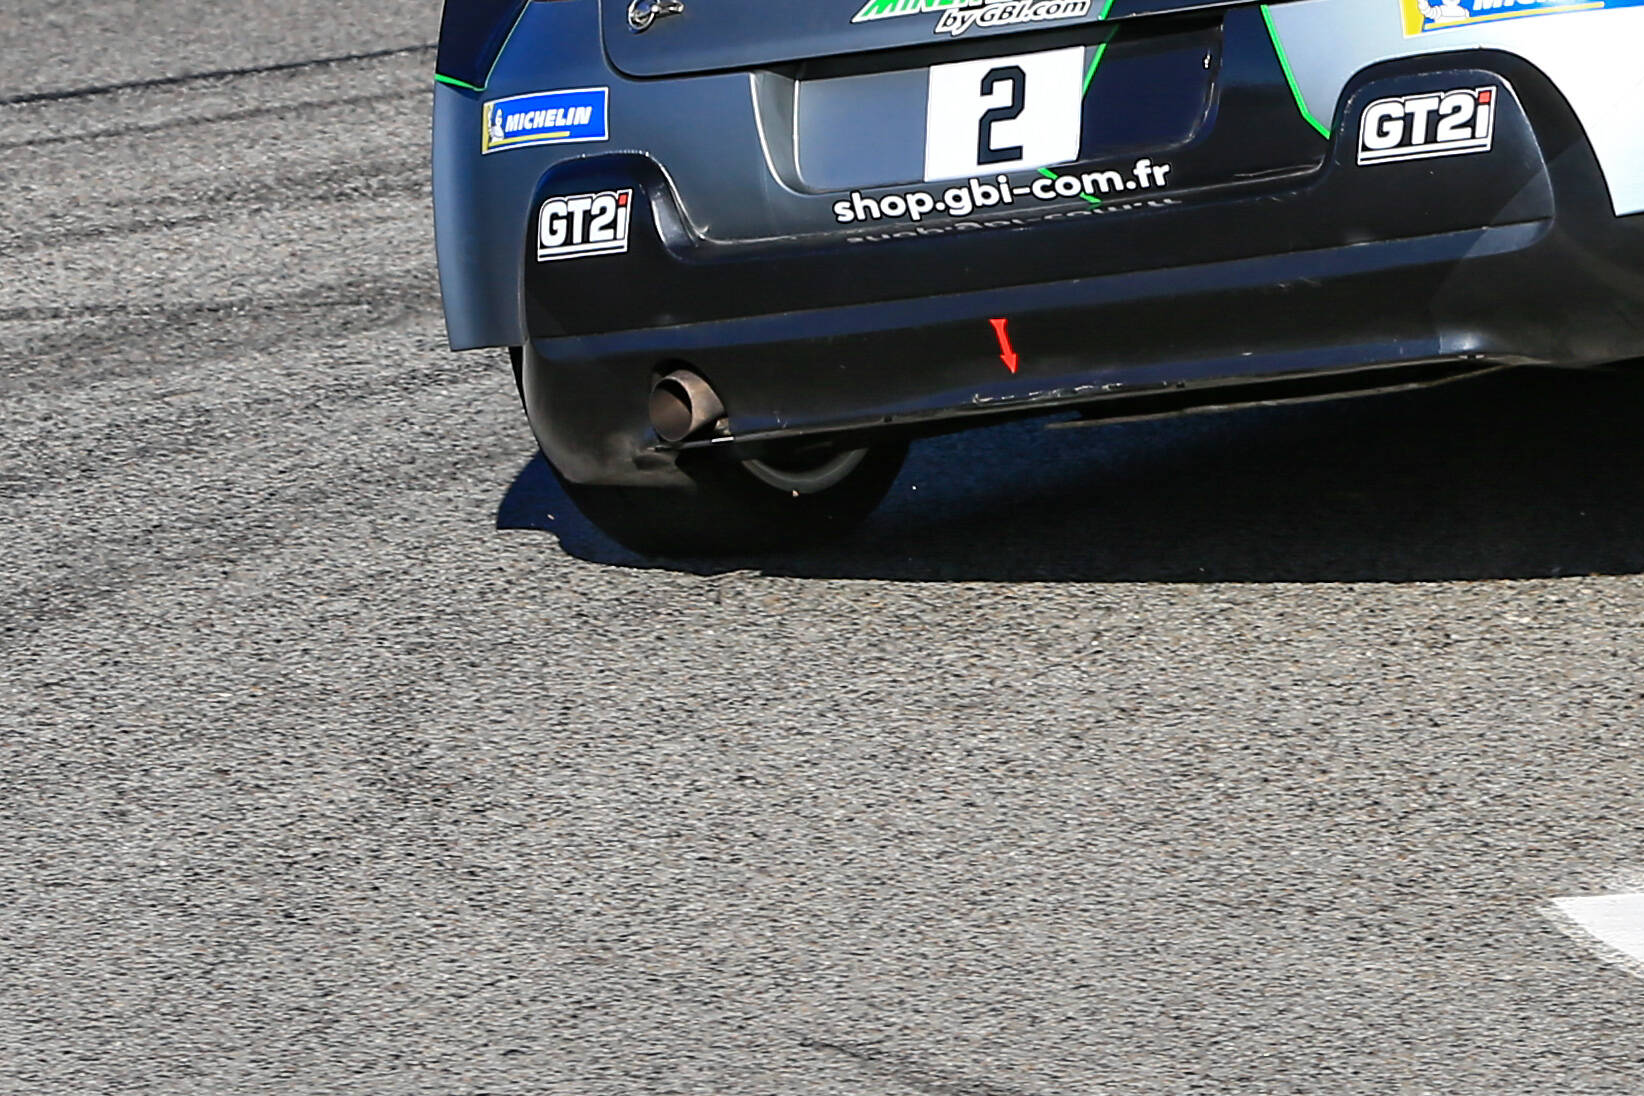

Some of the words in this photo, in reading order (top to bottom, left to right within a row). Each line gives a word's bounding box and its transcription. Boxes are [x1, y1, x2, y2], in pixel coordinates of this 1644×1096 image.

[505, 106, 592, 133] MICHELIN
[977, 65, 1028, 165] 2
[1363, 91, 1491, 150] GT2i
[540, 194, 628, 247] GT2i
[833, 159, 1171, 227] shop.gbi-com.fr
